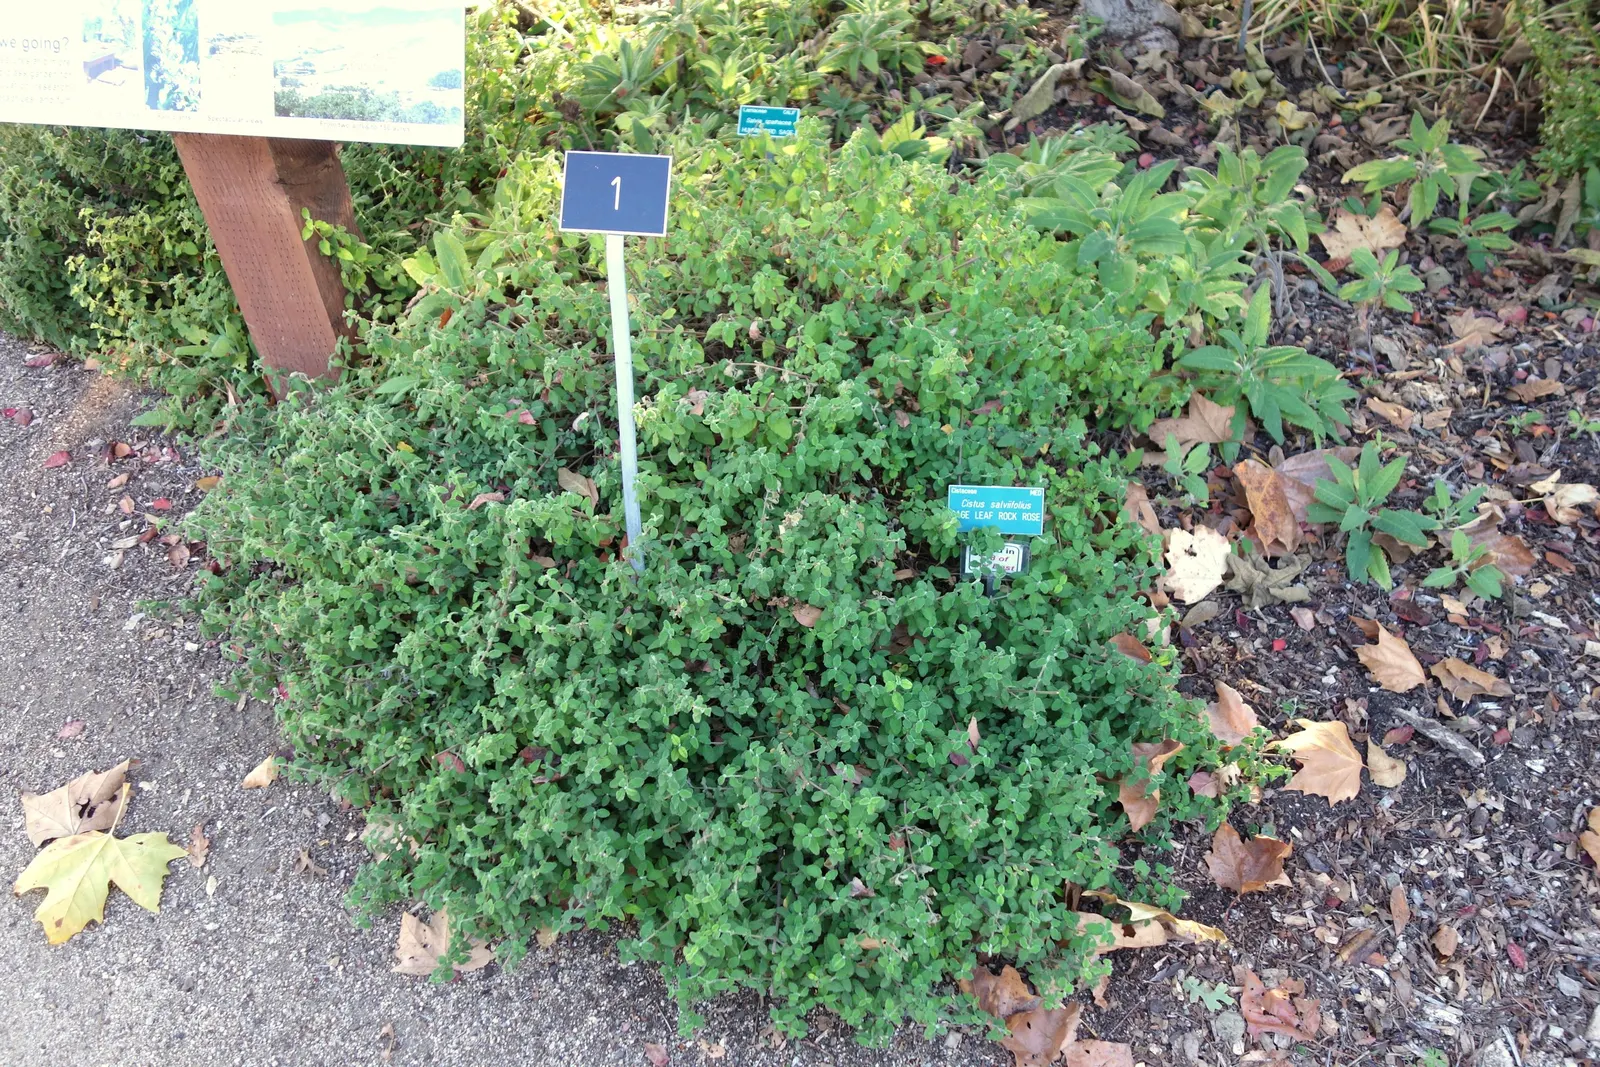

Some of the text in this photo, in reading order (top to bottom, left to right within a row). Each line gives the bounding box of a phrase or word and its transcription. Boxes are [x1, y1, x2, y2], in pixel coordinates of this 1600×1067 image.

[21, 36, 70, 54] going?
[611, 175, 622, 211] 1
[951, 487, 978, 495] Cistaceae
[961, 499, 1031, 510] Cistus salviifolius
[952, 509, 1041, 522] GE LEAF ROCK ROSE
[1005, 547, 1015, 555] in
